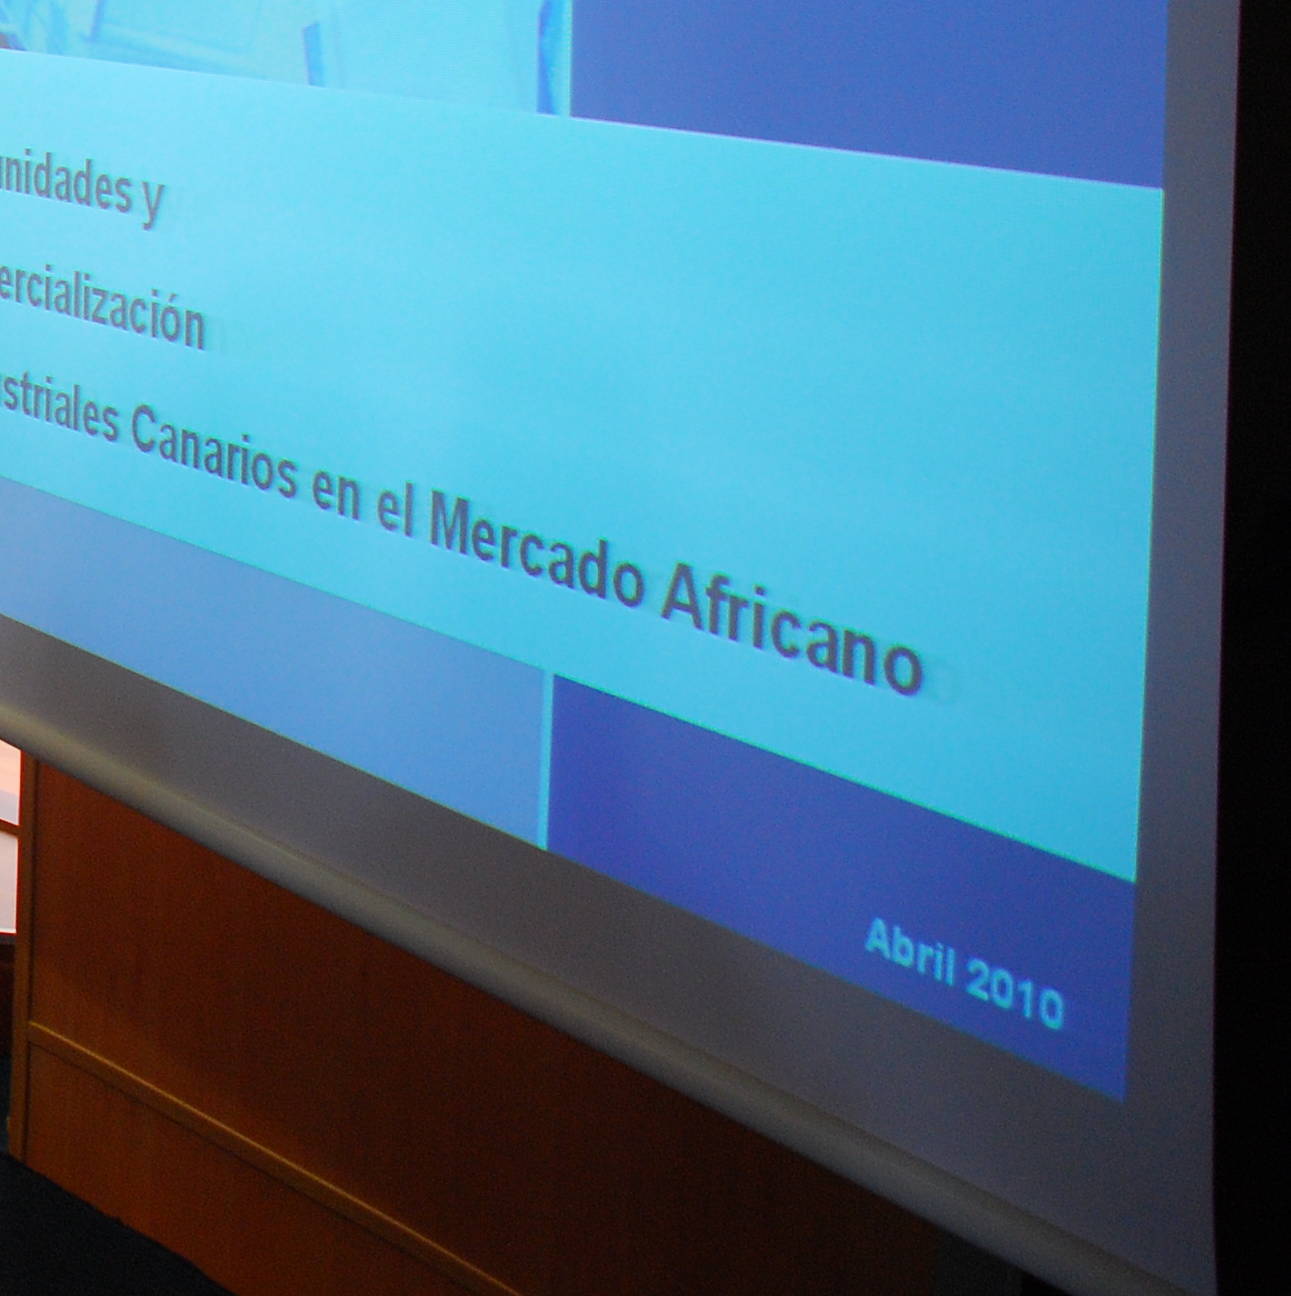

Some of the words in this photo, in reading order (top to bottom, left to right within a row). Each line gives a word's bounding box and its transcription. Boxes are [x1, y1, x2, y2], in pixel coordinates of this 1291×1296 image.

[140, 179, 164, 230] y
[131, 403, 298, 499] Canarios
[312, 469, 360, 520] en
[378, 482, 415, 537] el
[430, 489, 645, 609] Mercado
[661, 562, 924, 697] Africano
[865, 917, 956, 986] Abril
[966, 958, 1065, 1030] 2010
